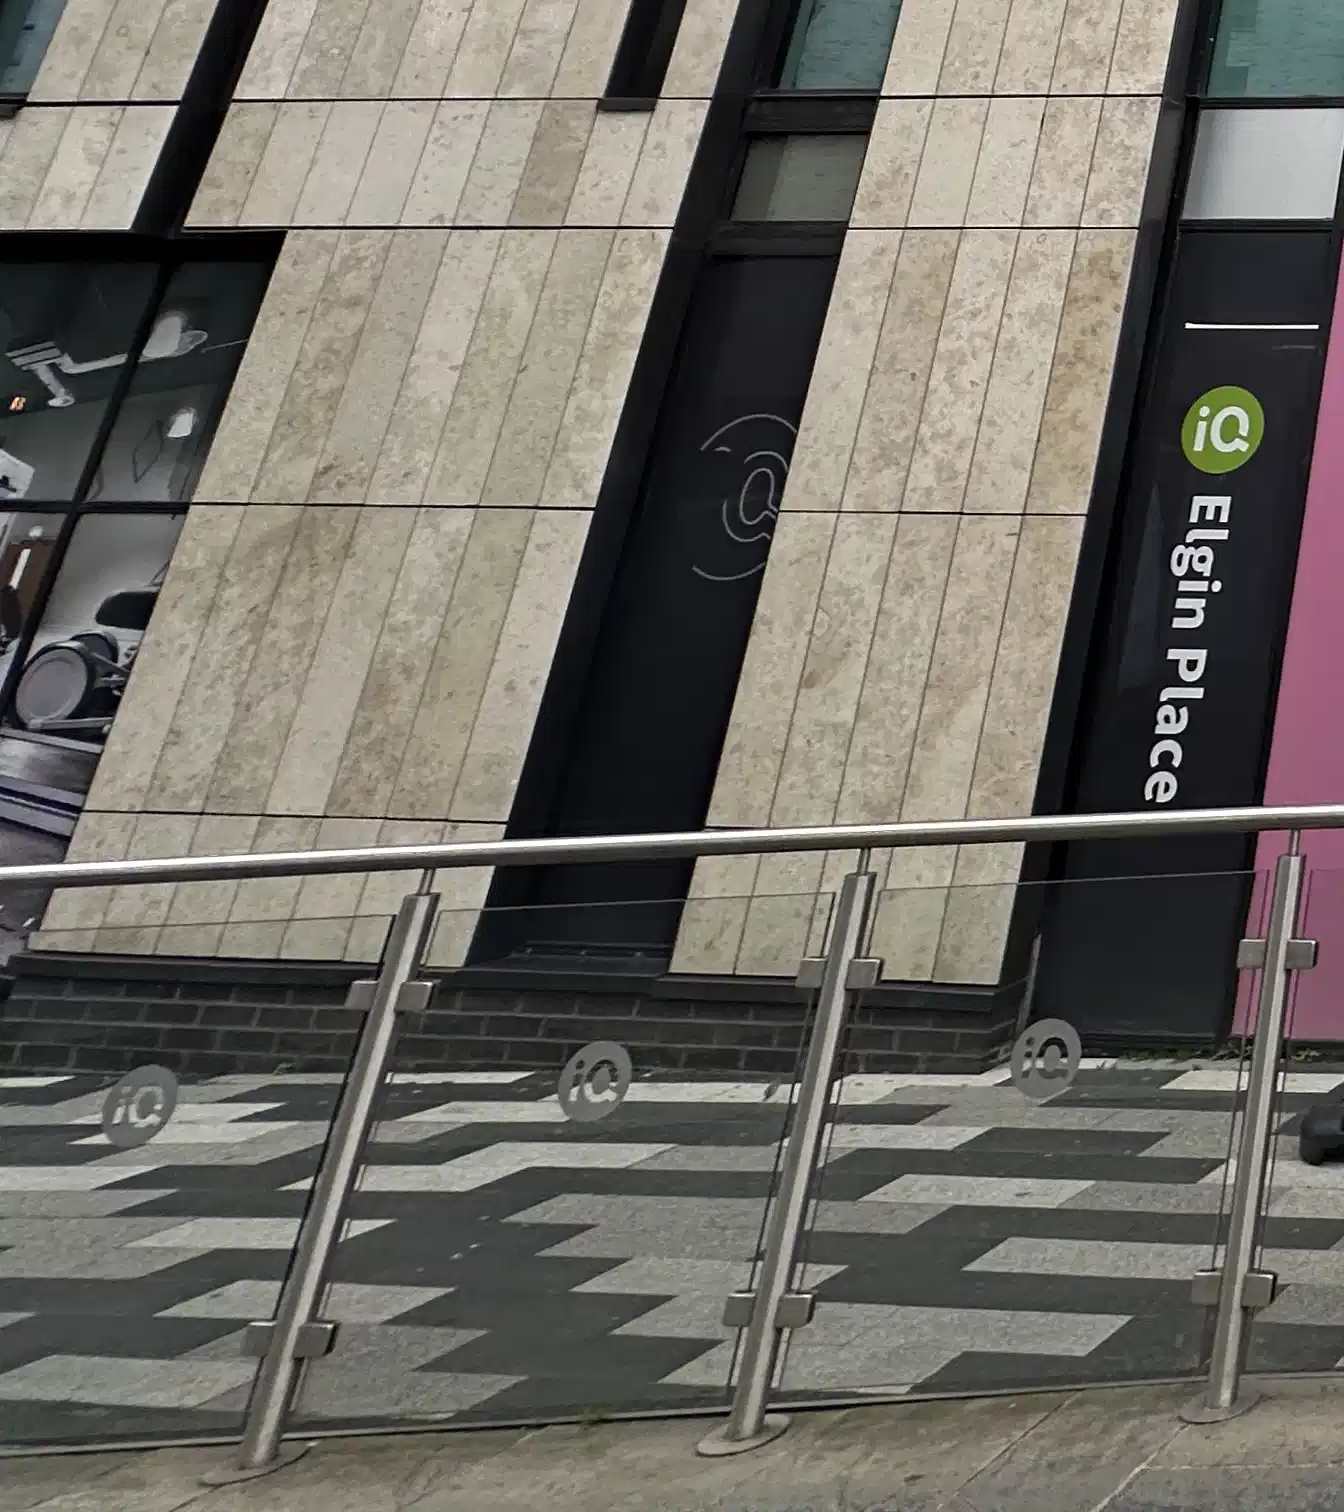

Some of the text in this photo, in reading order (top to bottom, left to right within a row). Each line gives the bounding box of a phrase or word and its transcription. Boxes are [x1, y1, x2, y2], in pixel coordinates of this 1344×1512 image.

[1193, 406, 1250, 453] iQ
[1144, 495, 1232, 804] Elgin Place
[1021, 1036, 1069, 1080] iQ
[568, 1059, 619, 1103] iQ
[110, 1086, 164, 1128] iQ
